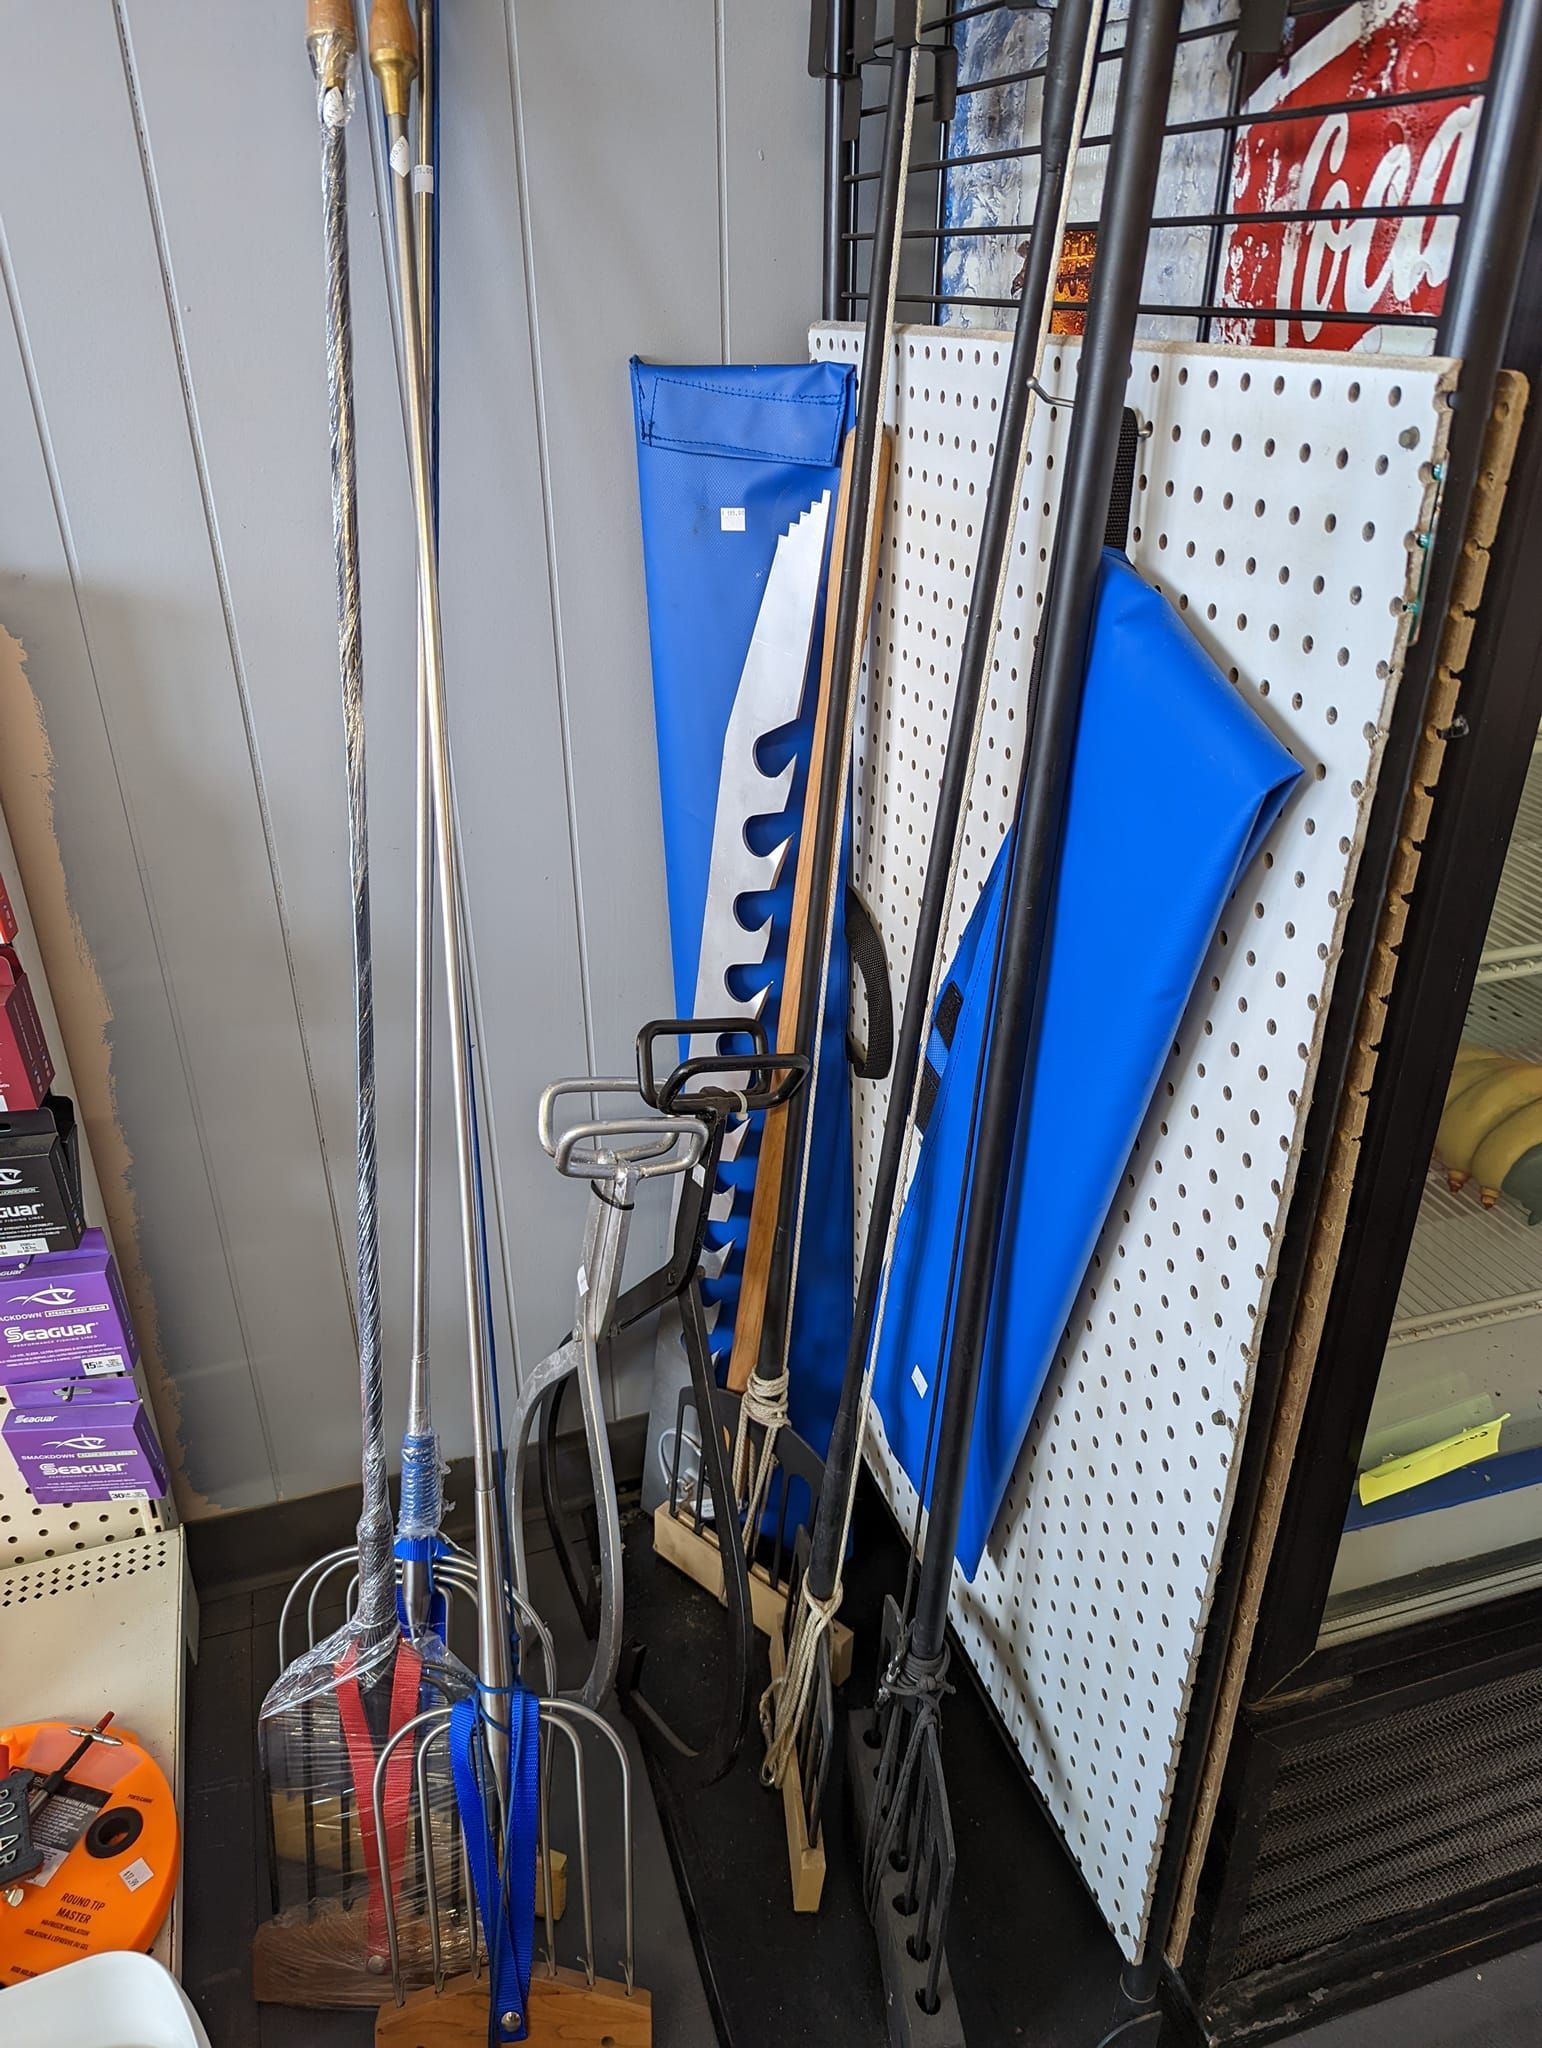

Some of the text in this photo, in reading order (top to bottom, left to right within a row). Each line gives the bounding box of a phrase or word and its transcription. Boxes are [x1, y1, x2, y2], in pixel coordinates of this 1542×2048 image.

[84, 1361, 97, 1369] 15
[61, 1893, 106, 1911] ROUND TIP
[56, 1907, 92, 1924] MASTER
